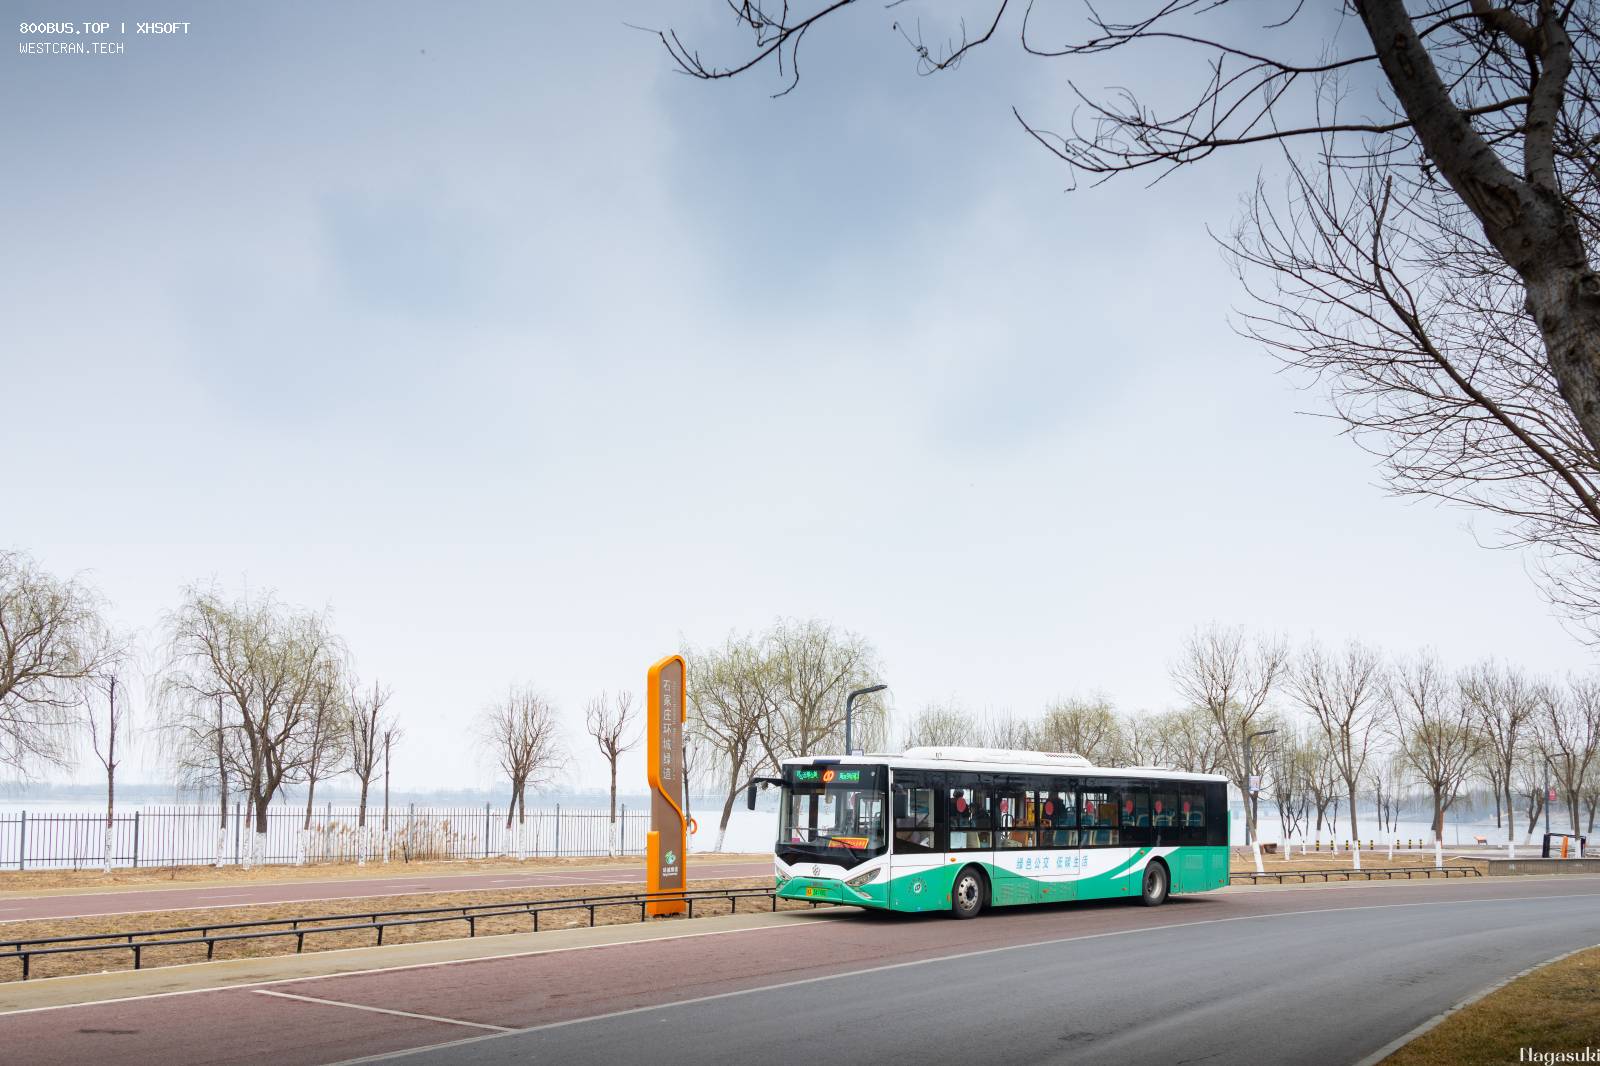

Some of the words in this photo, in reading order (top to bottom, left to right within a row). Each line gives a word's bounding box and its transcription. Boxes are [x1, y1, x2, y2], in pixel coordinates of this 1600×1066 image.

[1016, 856, 1049, 869] 绿色公交
[1056, 855, 1088, 868] 低碳生活
